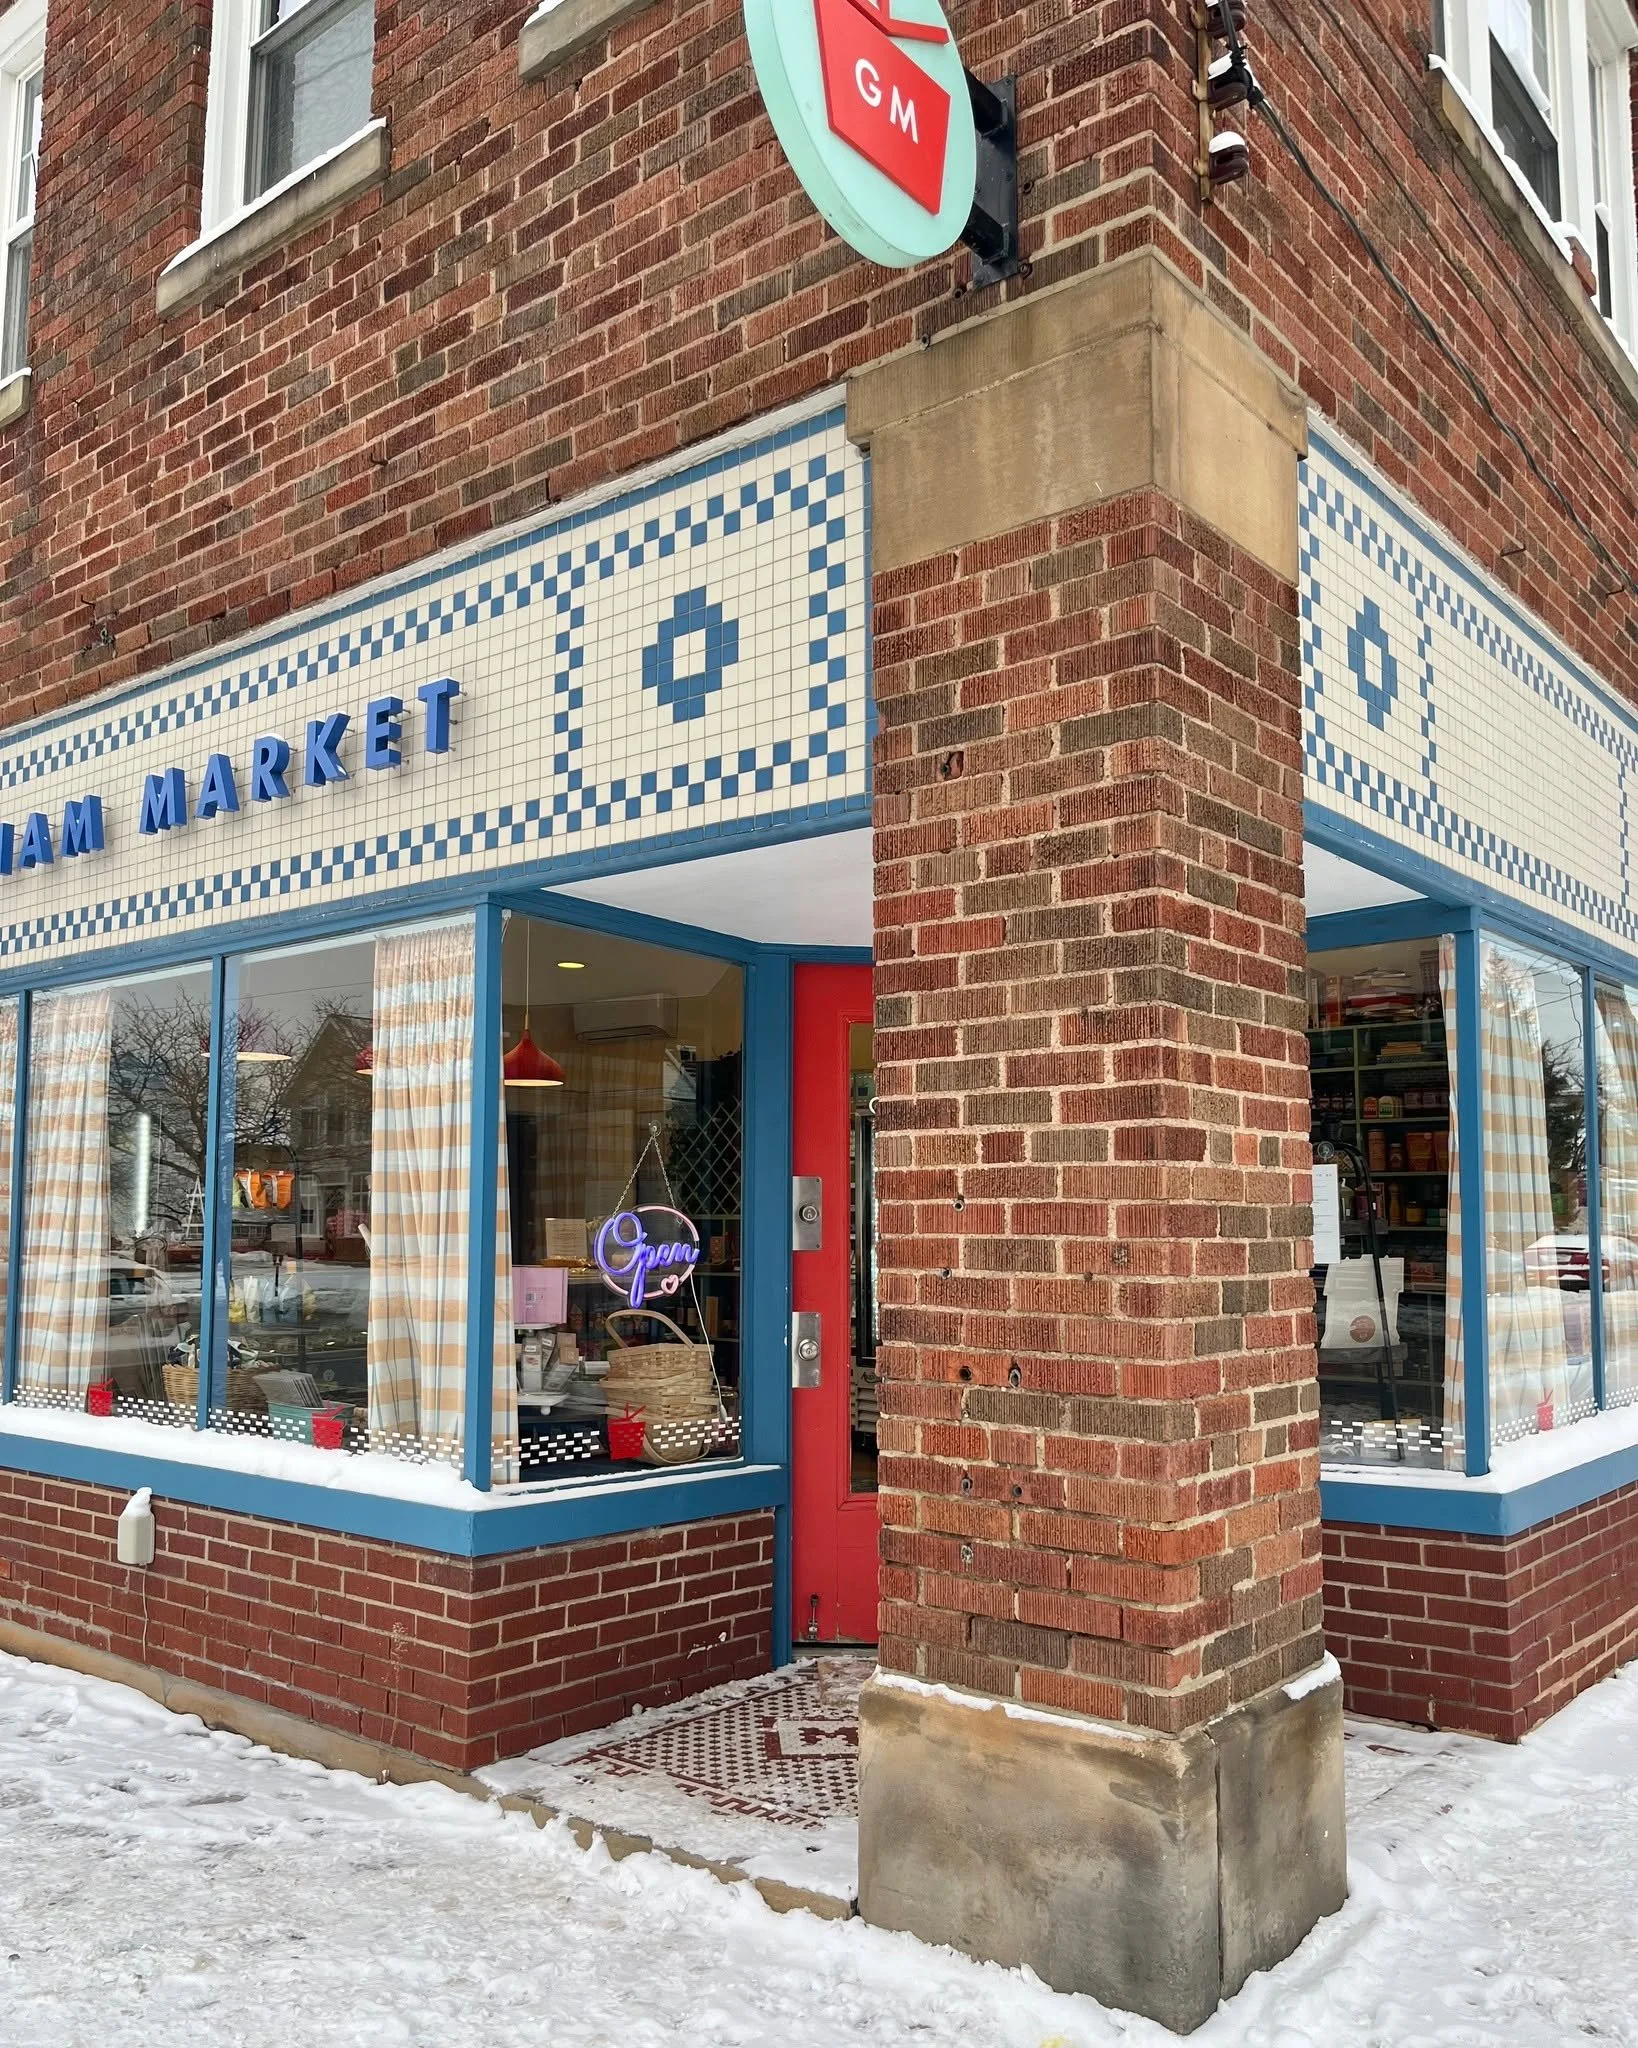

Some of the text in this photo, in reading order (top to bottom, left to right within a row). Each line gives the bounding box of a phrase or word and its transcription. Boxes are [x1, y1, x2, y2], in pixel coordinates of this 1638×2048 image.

[855, 57, 919, 145] GM
[0, 677, 461, 876] AM MARKET
[596, 1211, 700, 1309] Open
